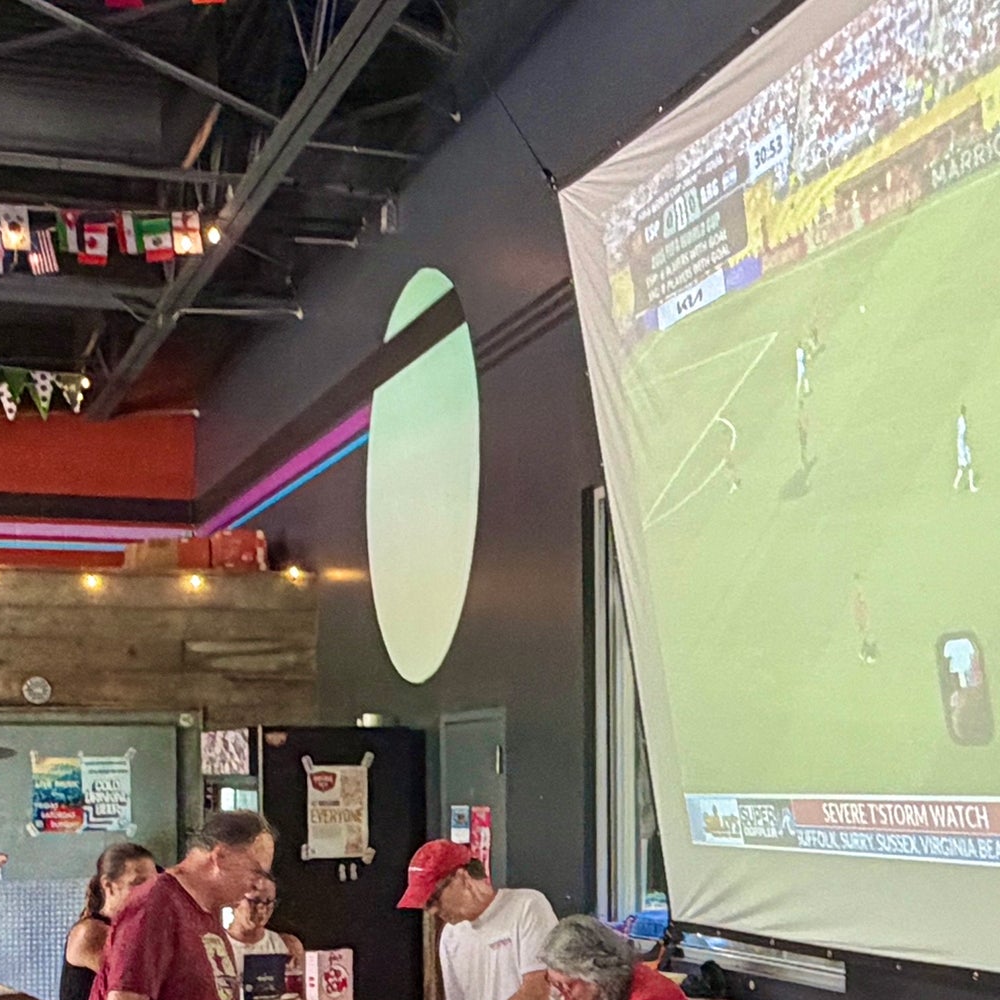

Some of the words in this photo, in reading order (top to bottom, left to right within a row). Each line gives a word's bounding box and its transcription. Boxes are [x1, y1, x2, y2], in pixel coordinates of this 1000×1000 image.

[754, 135, 783, 169] 30:53
[311, 807, 363, 824] EVERYONE
[822, 802, 868, 824] SEVERE
[867, 803, 929, 827] T'STORM
[929, 804, 990, 830] WATCH
